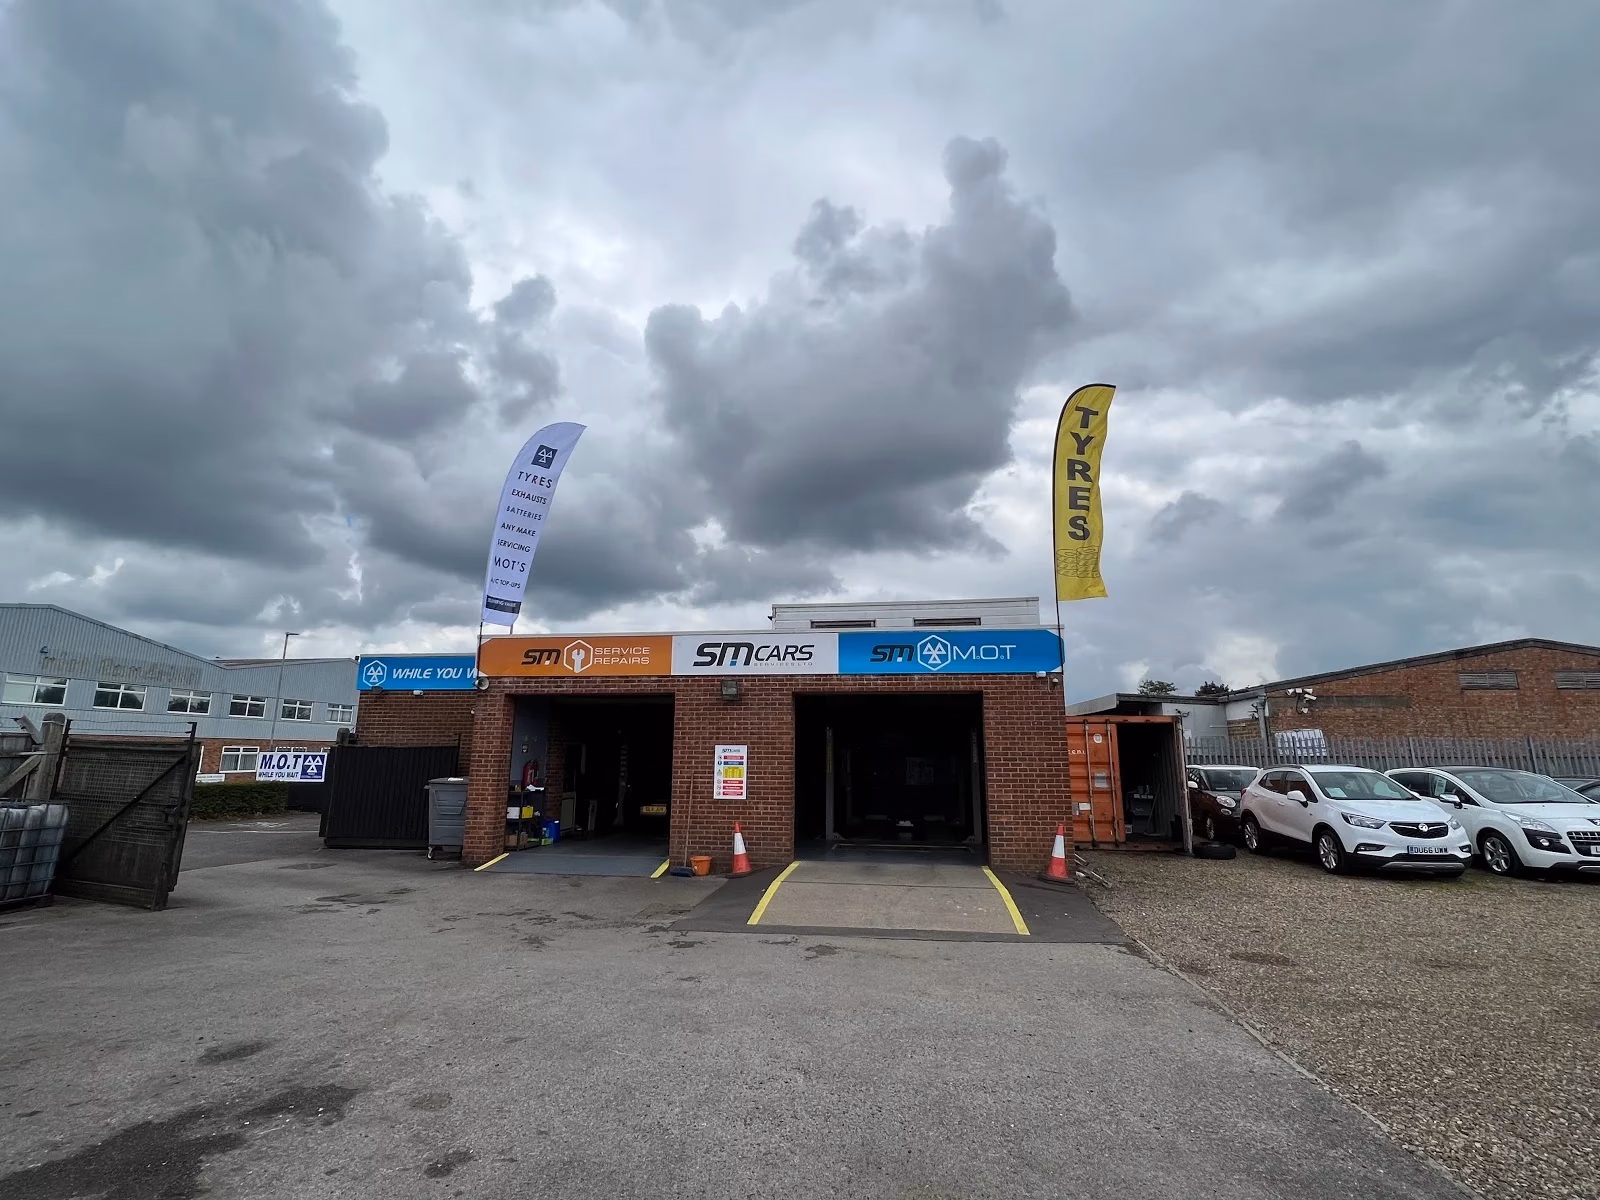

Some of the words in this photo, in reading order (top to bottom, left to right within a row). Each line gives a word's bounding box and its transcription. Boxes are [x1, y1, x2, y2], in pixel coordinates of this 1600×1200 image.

[518, 471, 552, 489] TYRES
[1067, 405, 1099, 541] TYRES
[511, 489, 547, 505] EXHAUSTS
[506, 505, 542, 521] BATTERIES
[501, 522, 516, 532] ANY
[516, 527, 536, 537] MAKE
[594, 647, 650, 655] SERVICE
[755, 645, 815, 662] CARS
[953, 645, 1016, 660] M.O.T
[594, 657, 650, 665] REPAIRS
[392, 668, 433, 679] WHILE
[436, 668, 462, 679] YOU
[260, 754, 302, 770] M.O.T
